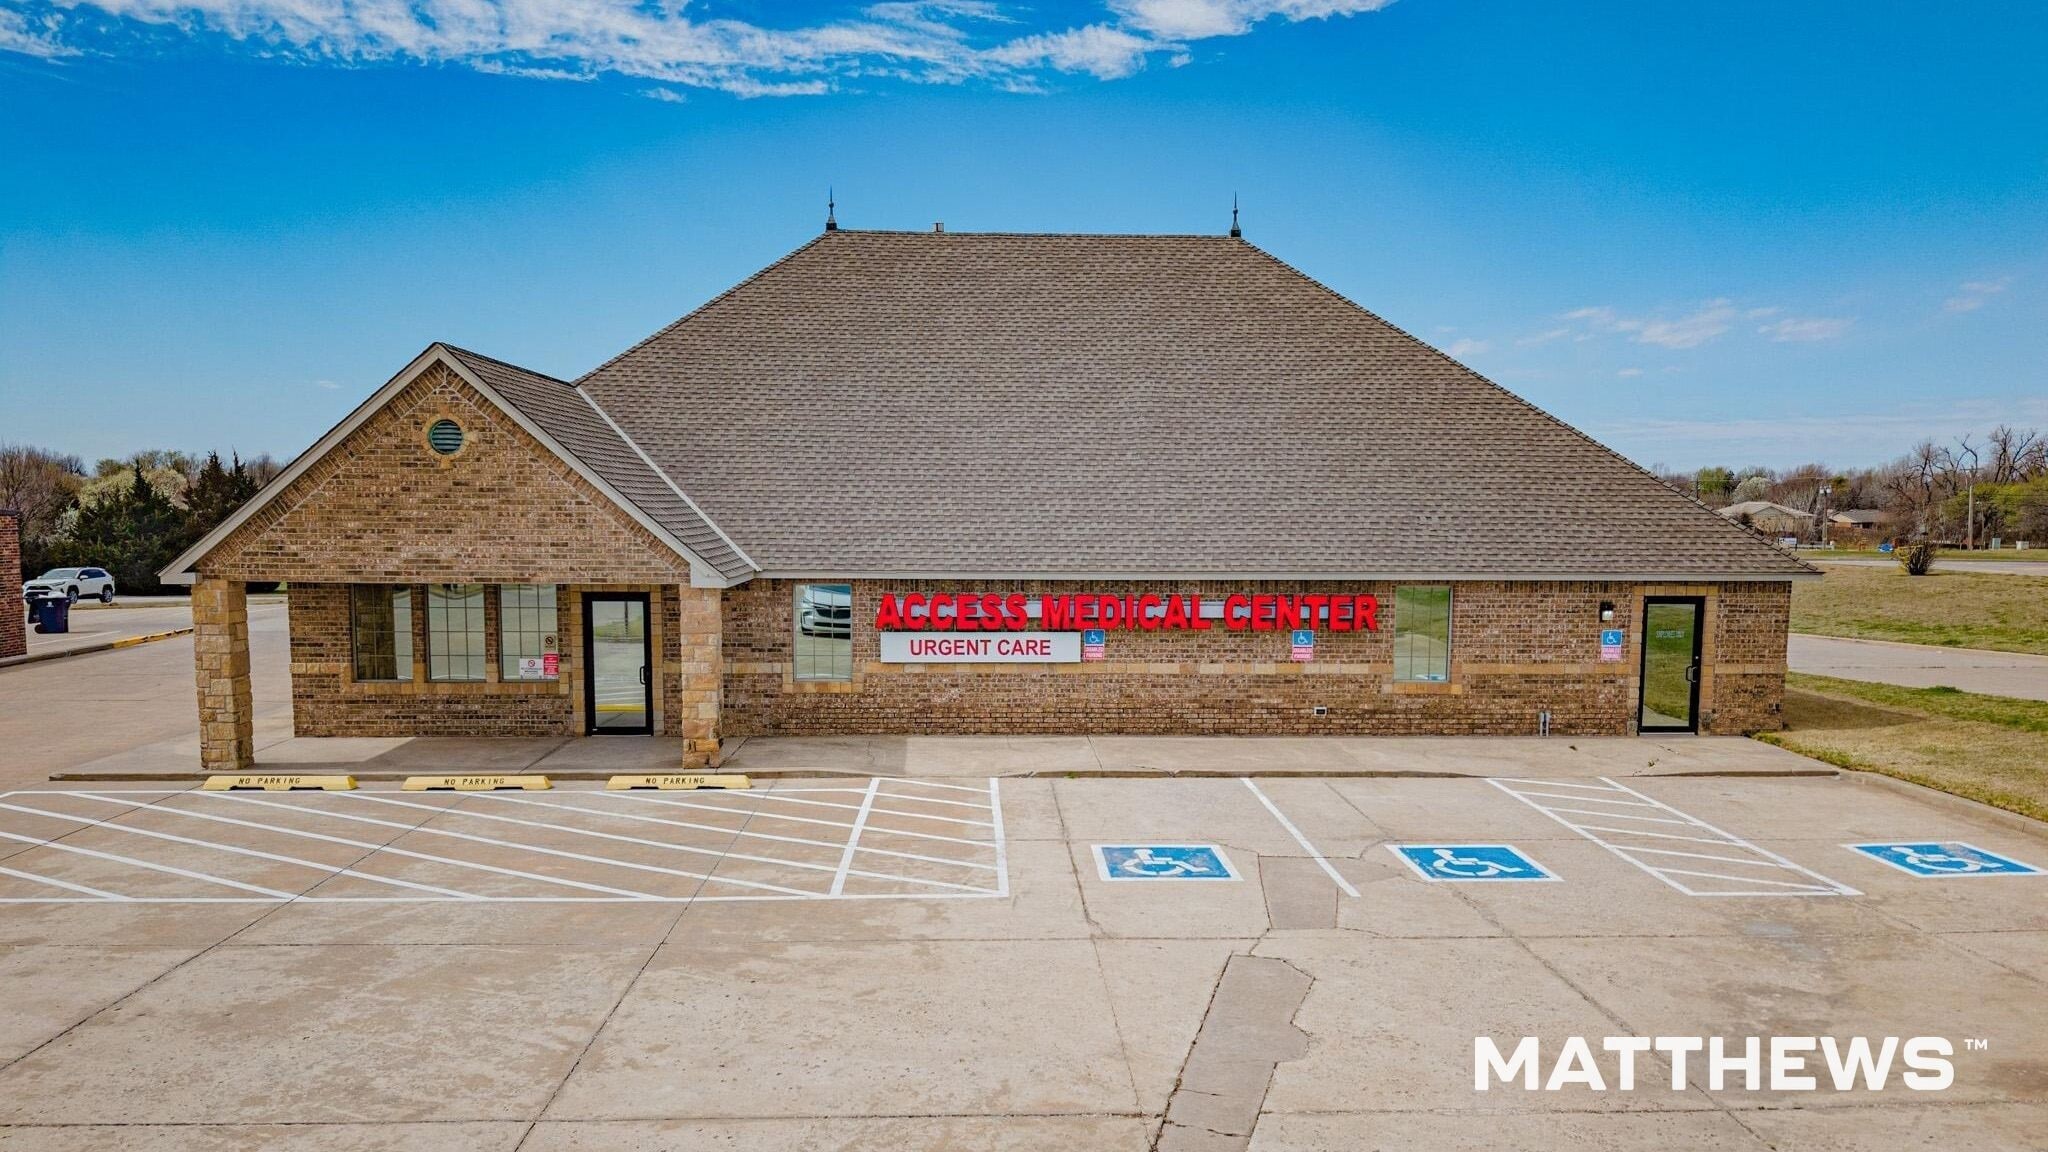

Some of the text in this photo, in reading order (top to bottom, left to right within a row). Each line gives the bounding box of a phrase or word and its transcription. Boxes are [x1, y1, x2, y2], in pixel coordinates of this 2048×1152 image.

[874, 592, 1379, 632] ACCESS MEDICAL CENTER
[909, 640, 1052, 655] URGENT CARE
[463, 777, 505, 785] PARKING
[645, 777, 706, 785] NO PARKING
